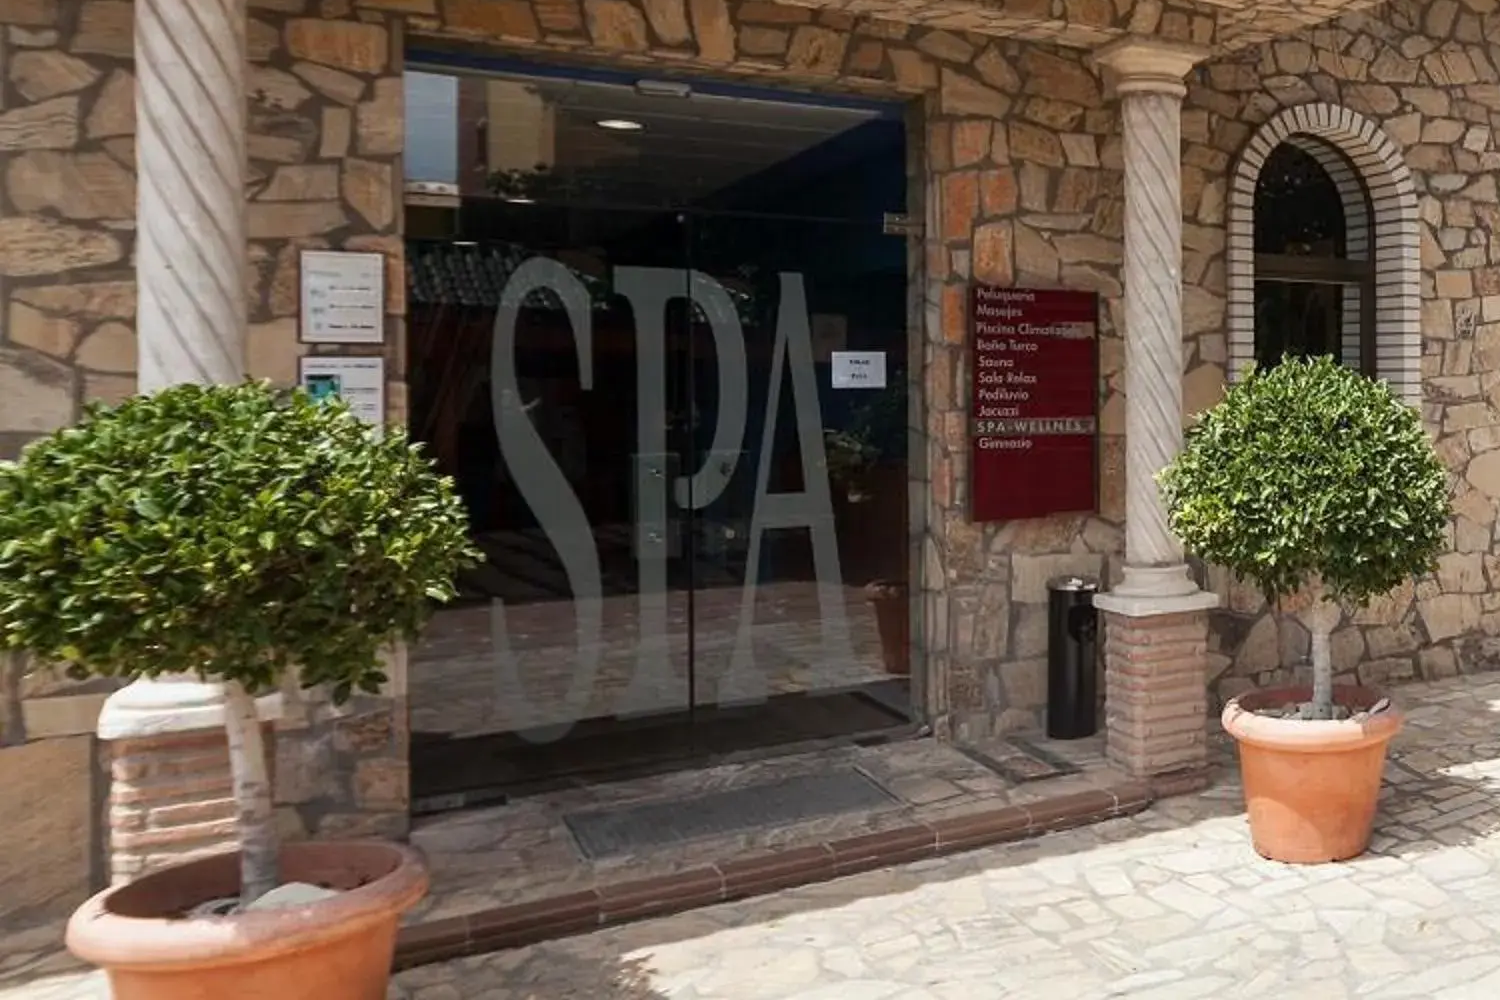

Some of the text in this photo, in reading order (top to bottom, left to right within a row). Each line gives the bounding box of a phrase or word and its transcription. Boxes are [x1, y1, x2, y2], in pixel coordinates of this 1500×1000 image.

[976, 304, 1023, 320] Masajes
[976, 322, 1015, 335] Piscina
[977, 339, 1006, 351] Baño
[979, 356, 1014, 367] Sauna
[979, 371, 1037, 383] Sala Relax
[979, 405, 1020, 416] Jacuzzi
[979, 436, 1033, 449] Gimnasio
[491, 256, 860, 745] SPA
